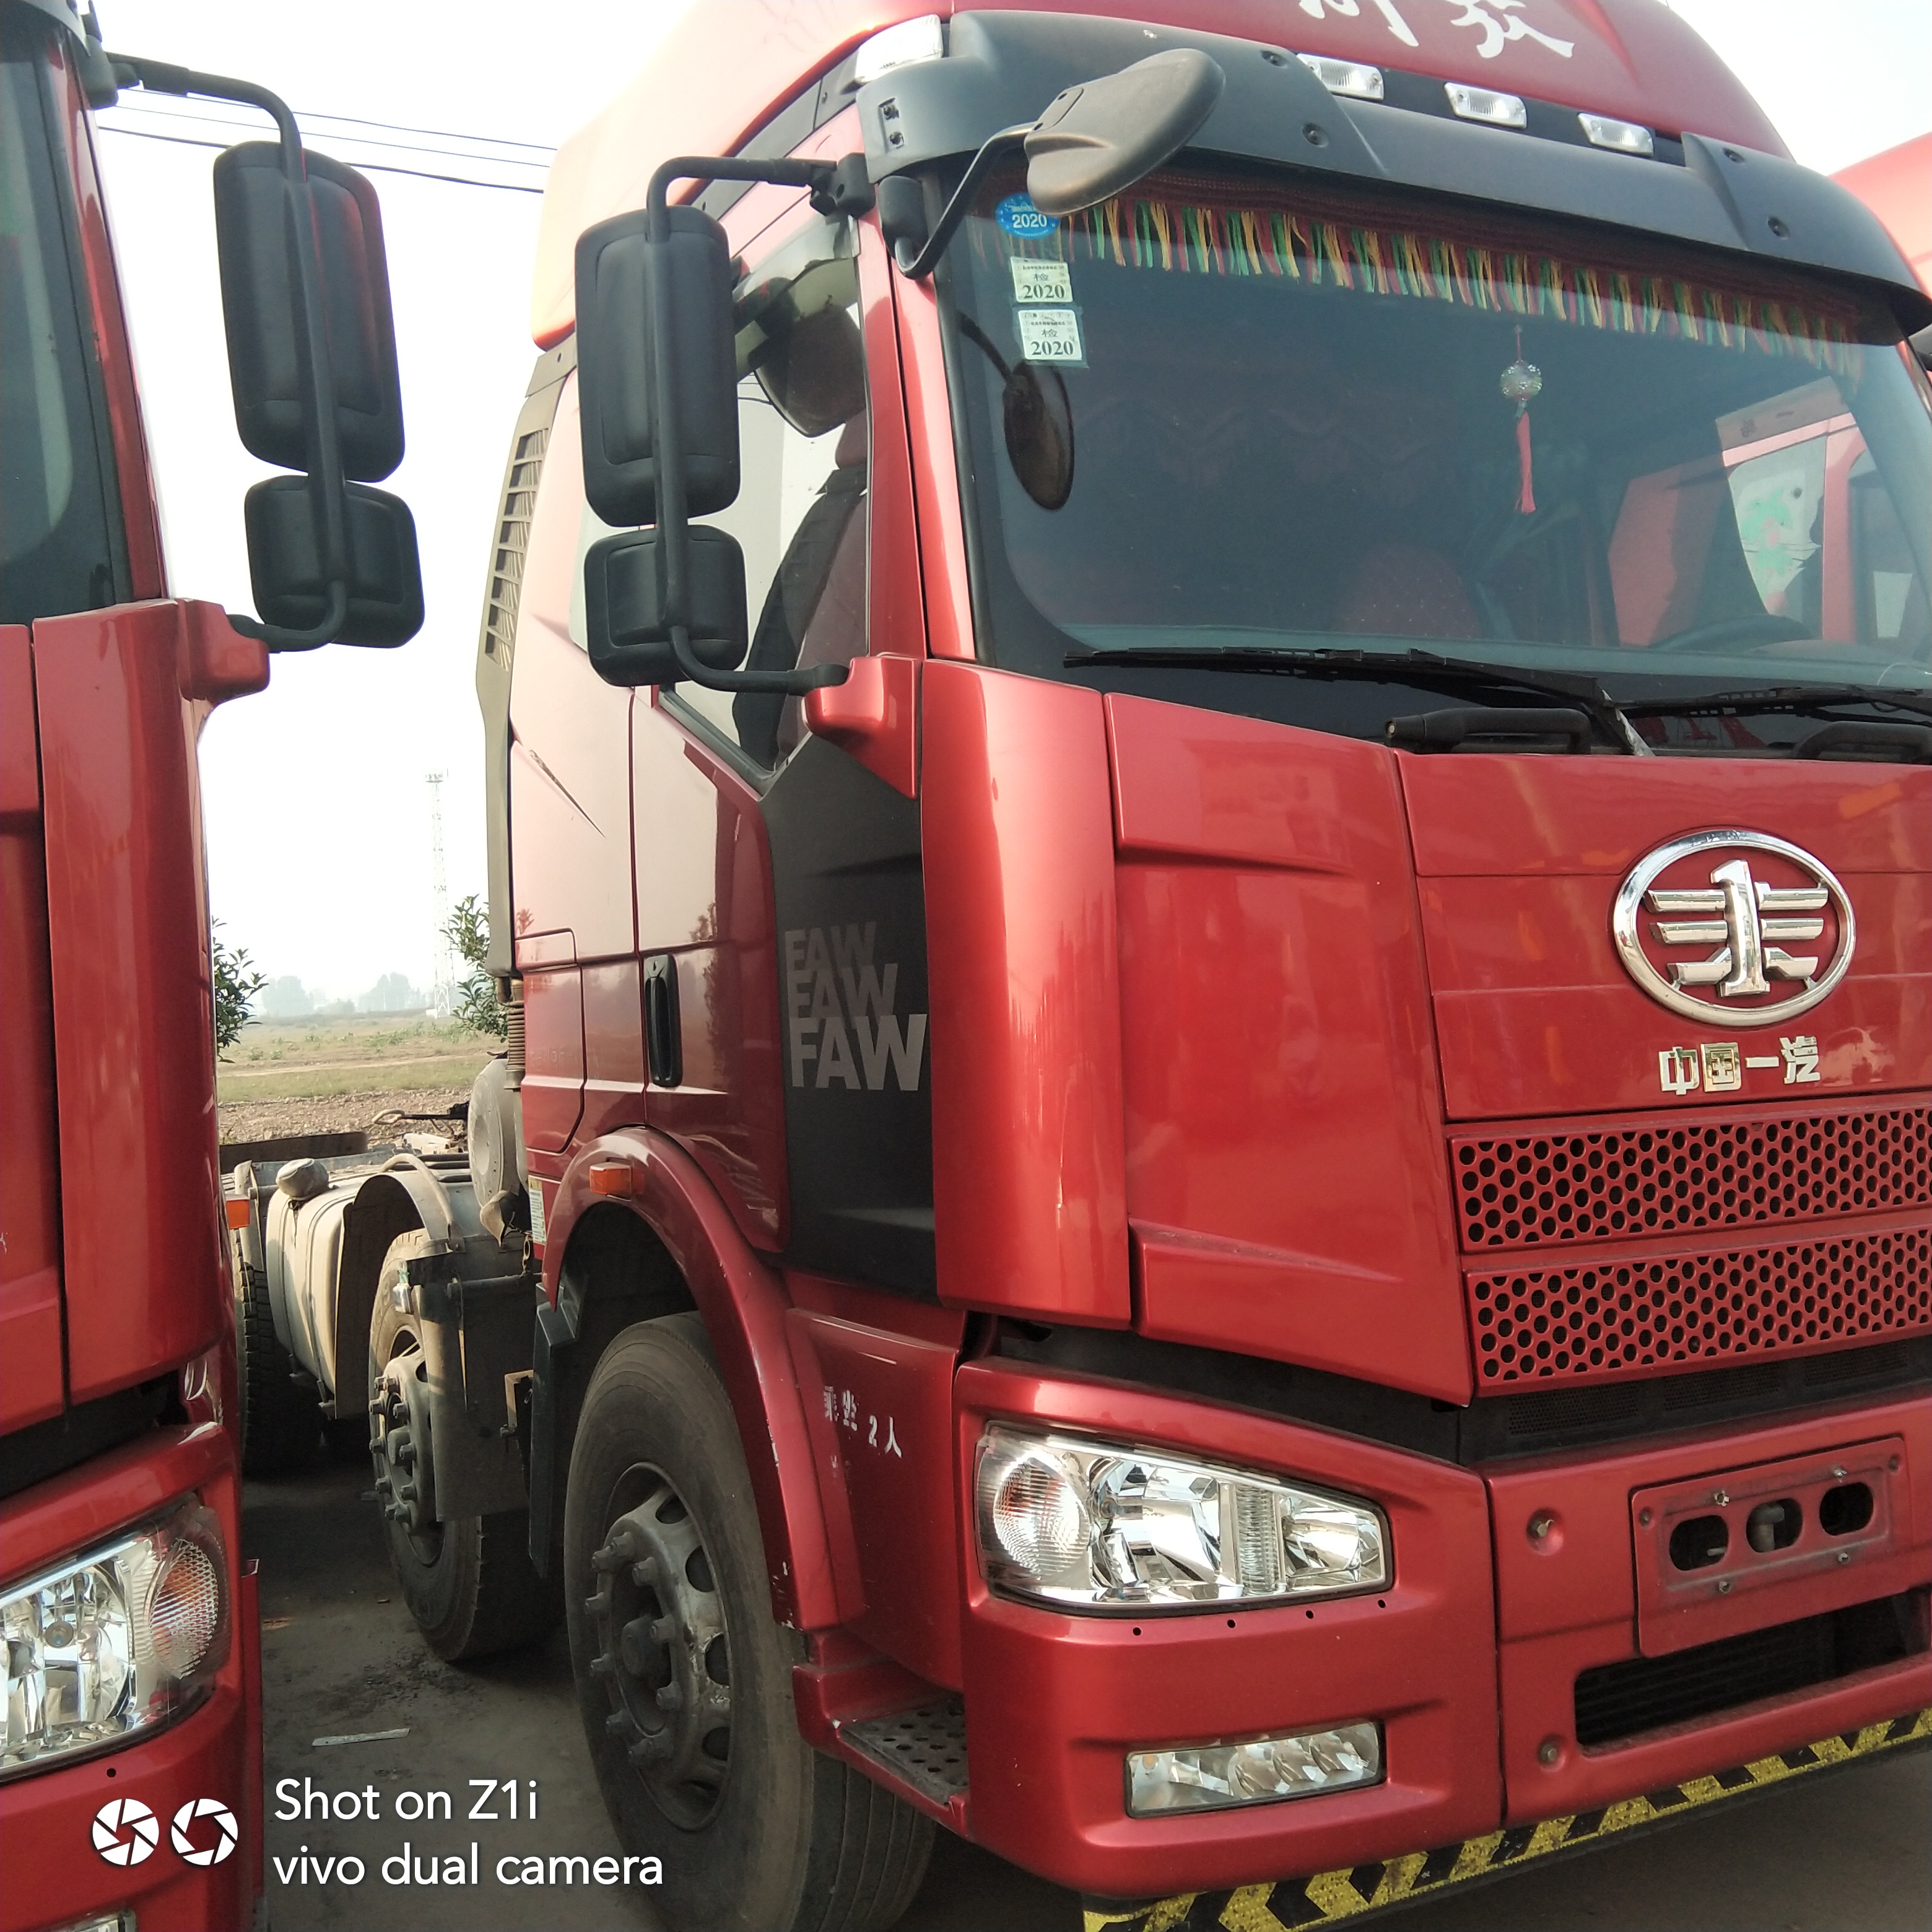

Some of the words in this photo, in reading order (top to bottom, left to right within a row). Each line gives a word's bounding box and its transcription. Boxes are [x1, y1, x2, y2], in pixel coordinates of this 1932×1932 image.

[1012, 214, 1048, 228] 2020
[1022, 284, 1065, 298] 2020
[1042, 328, 1058, 338] 检
[1030, 341, 1074, 355] 2020
[789, 1014, 928, 1091] FAW
[1658, 1035, 1821, 1095] 中国一汽
